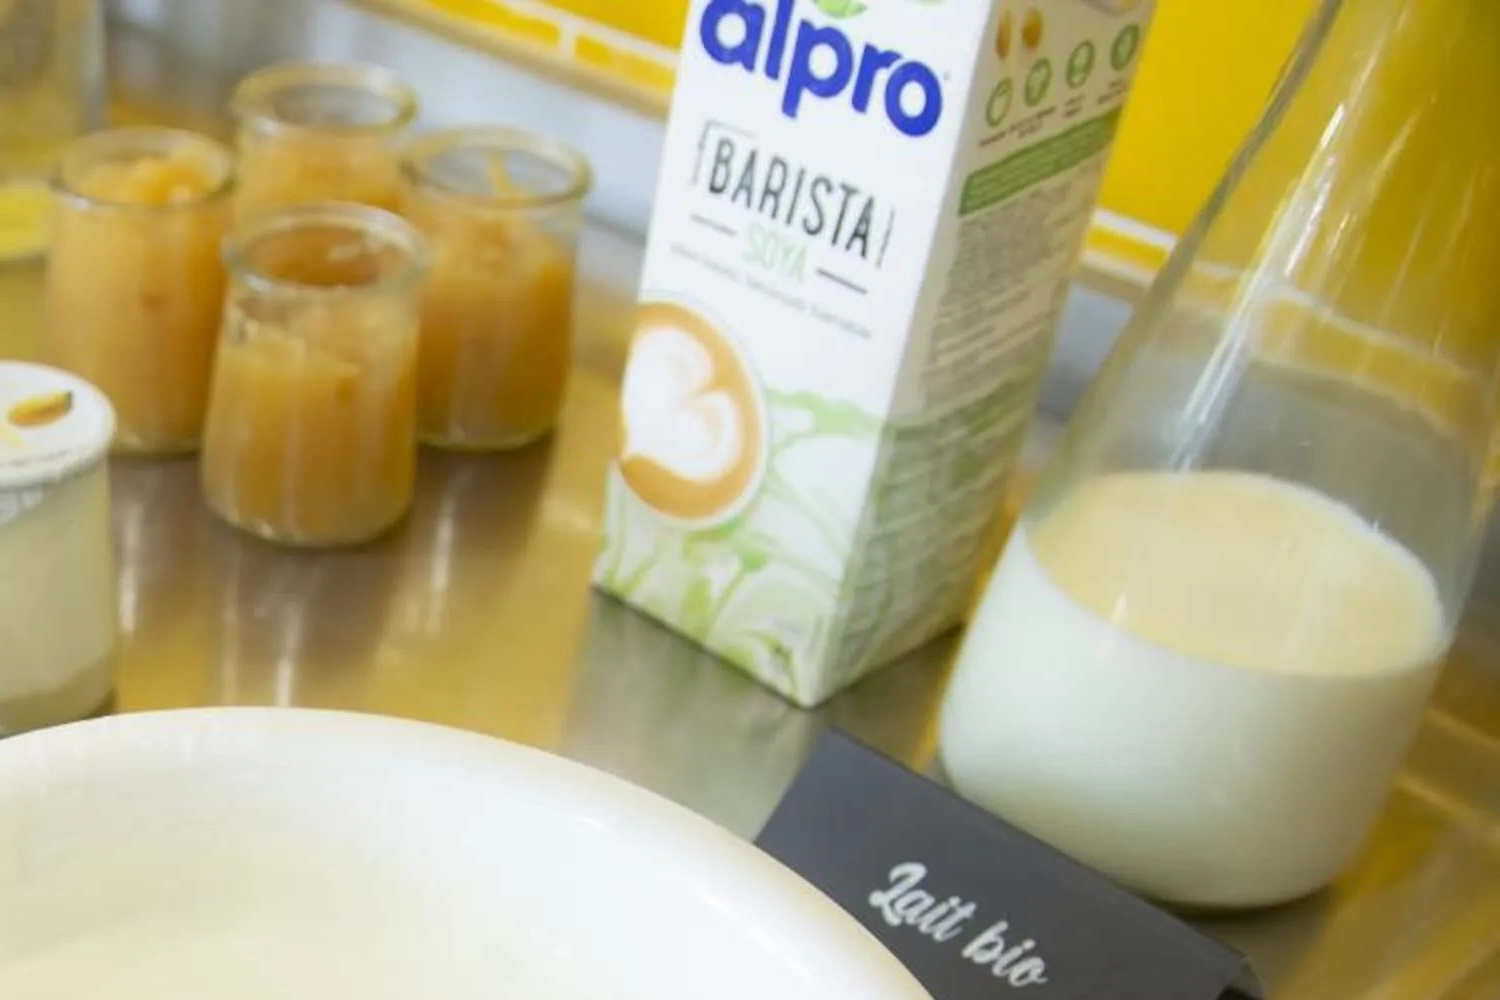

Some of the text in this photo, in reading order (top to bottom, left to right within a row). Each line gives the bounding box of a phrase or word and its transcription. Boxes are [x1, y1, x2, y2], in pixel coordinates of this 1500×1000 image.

[699, 0, 943, 138] alpro
[708, 137, 875, 261] BARISTA
[742, 222, 807, 284] SOYA
[868, 862, 1049, 988] Lait bio
